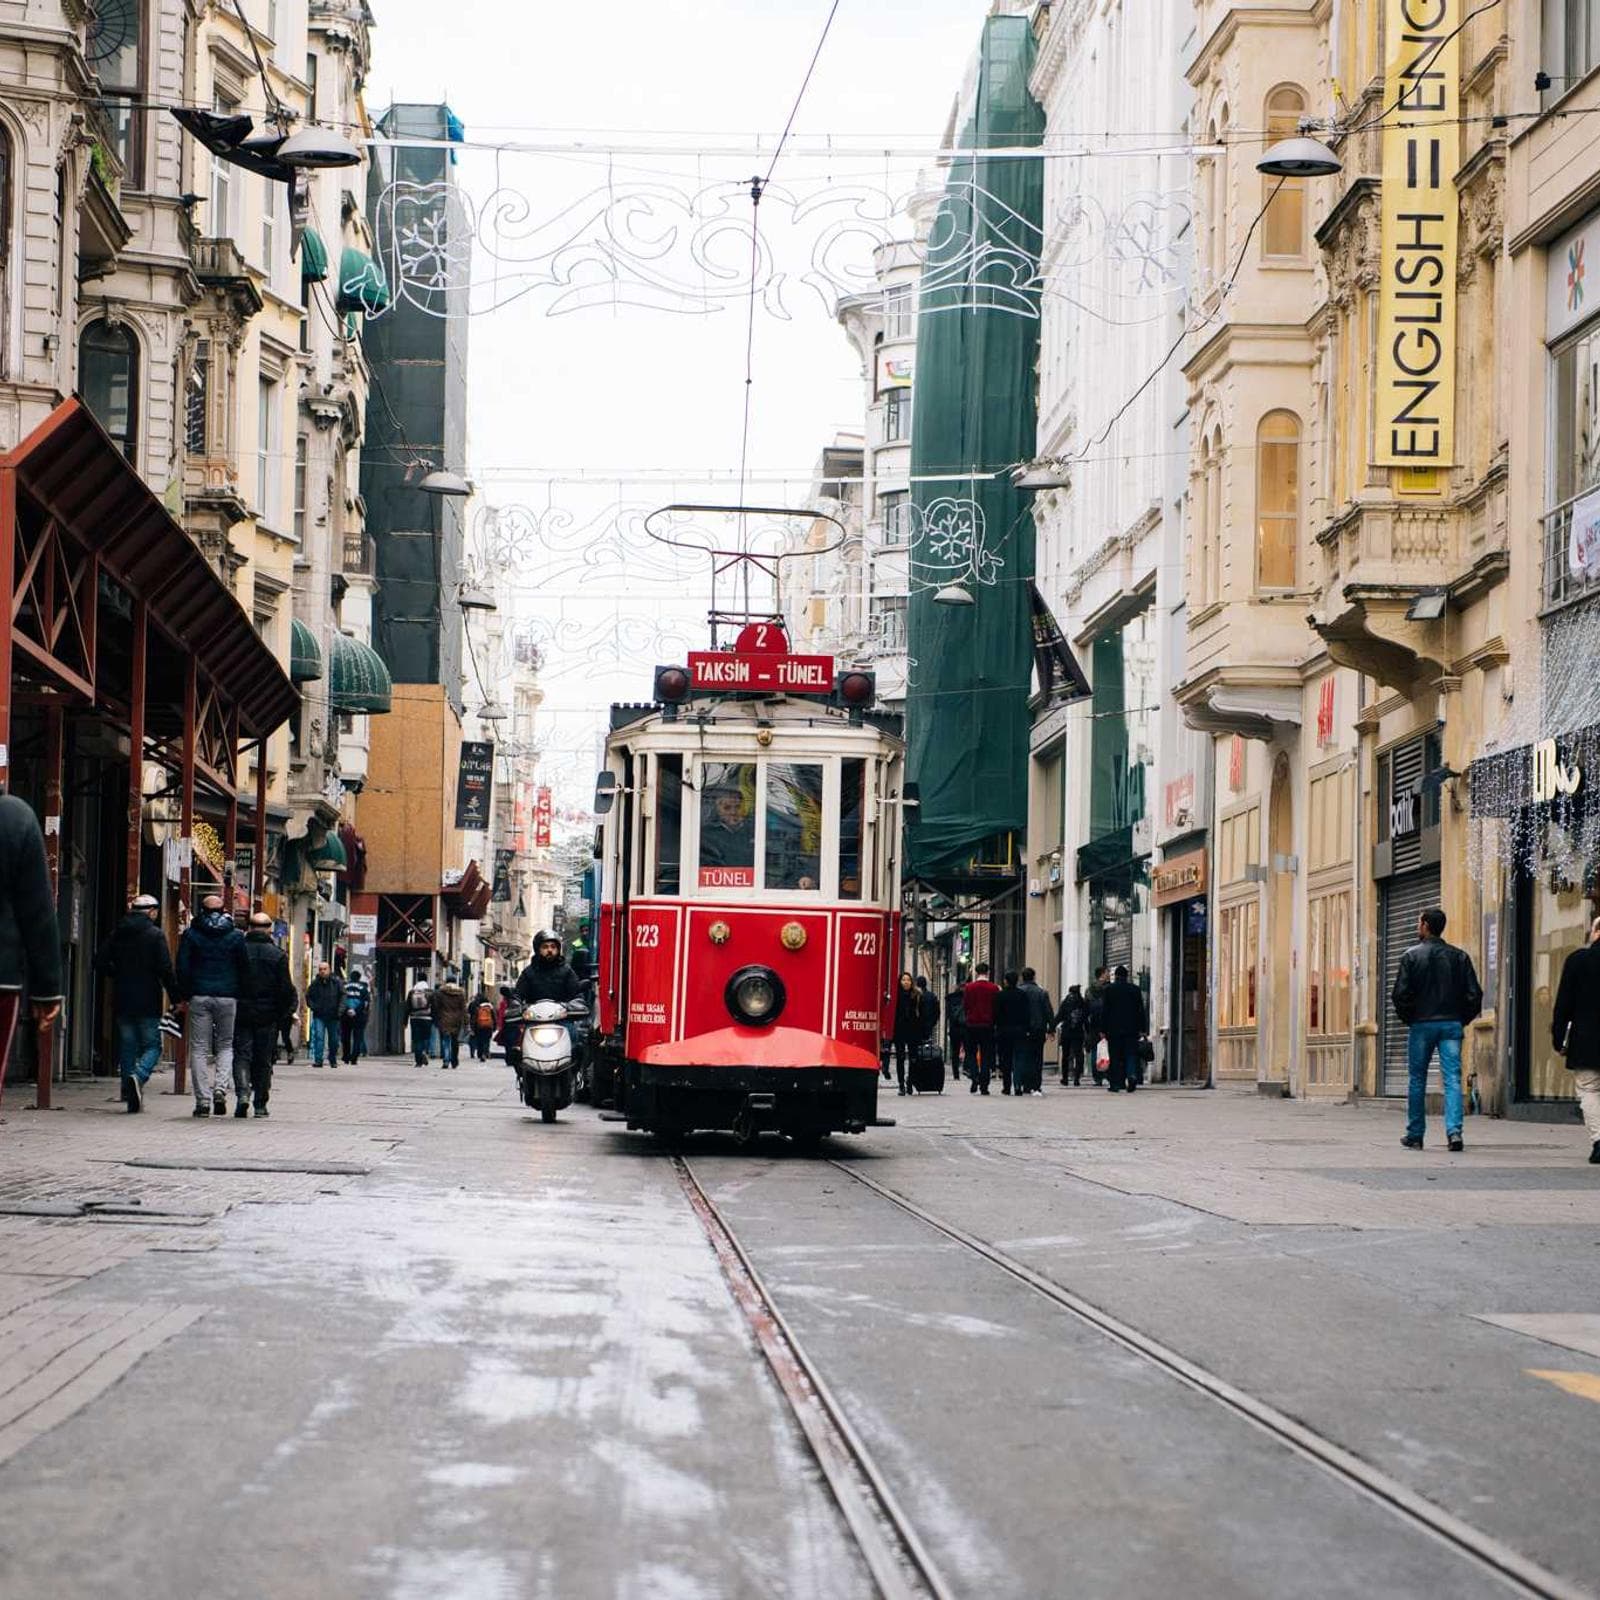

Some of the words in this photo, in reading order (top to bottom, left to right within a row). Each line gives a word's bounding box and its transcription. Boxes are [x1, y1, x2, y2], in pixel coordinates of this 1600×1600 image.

[1391, 213, 1444, 457] ENGLISH
[756, 624, 767, 648] 2
[695, 661, 750, 682] TAKSİM
[776, 664, 828, 685] TÜNEL
[702, 868, 751, 886] TÜNEL
[636, 924, 659, 947] 223
[853, 932, 876, 955] 223
